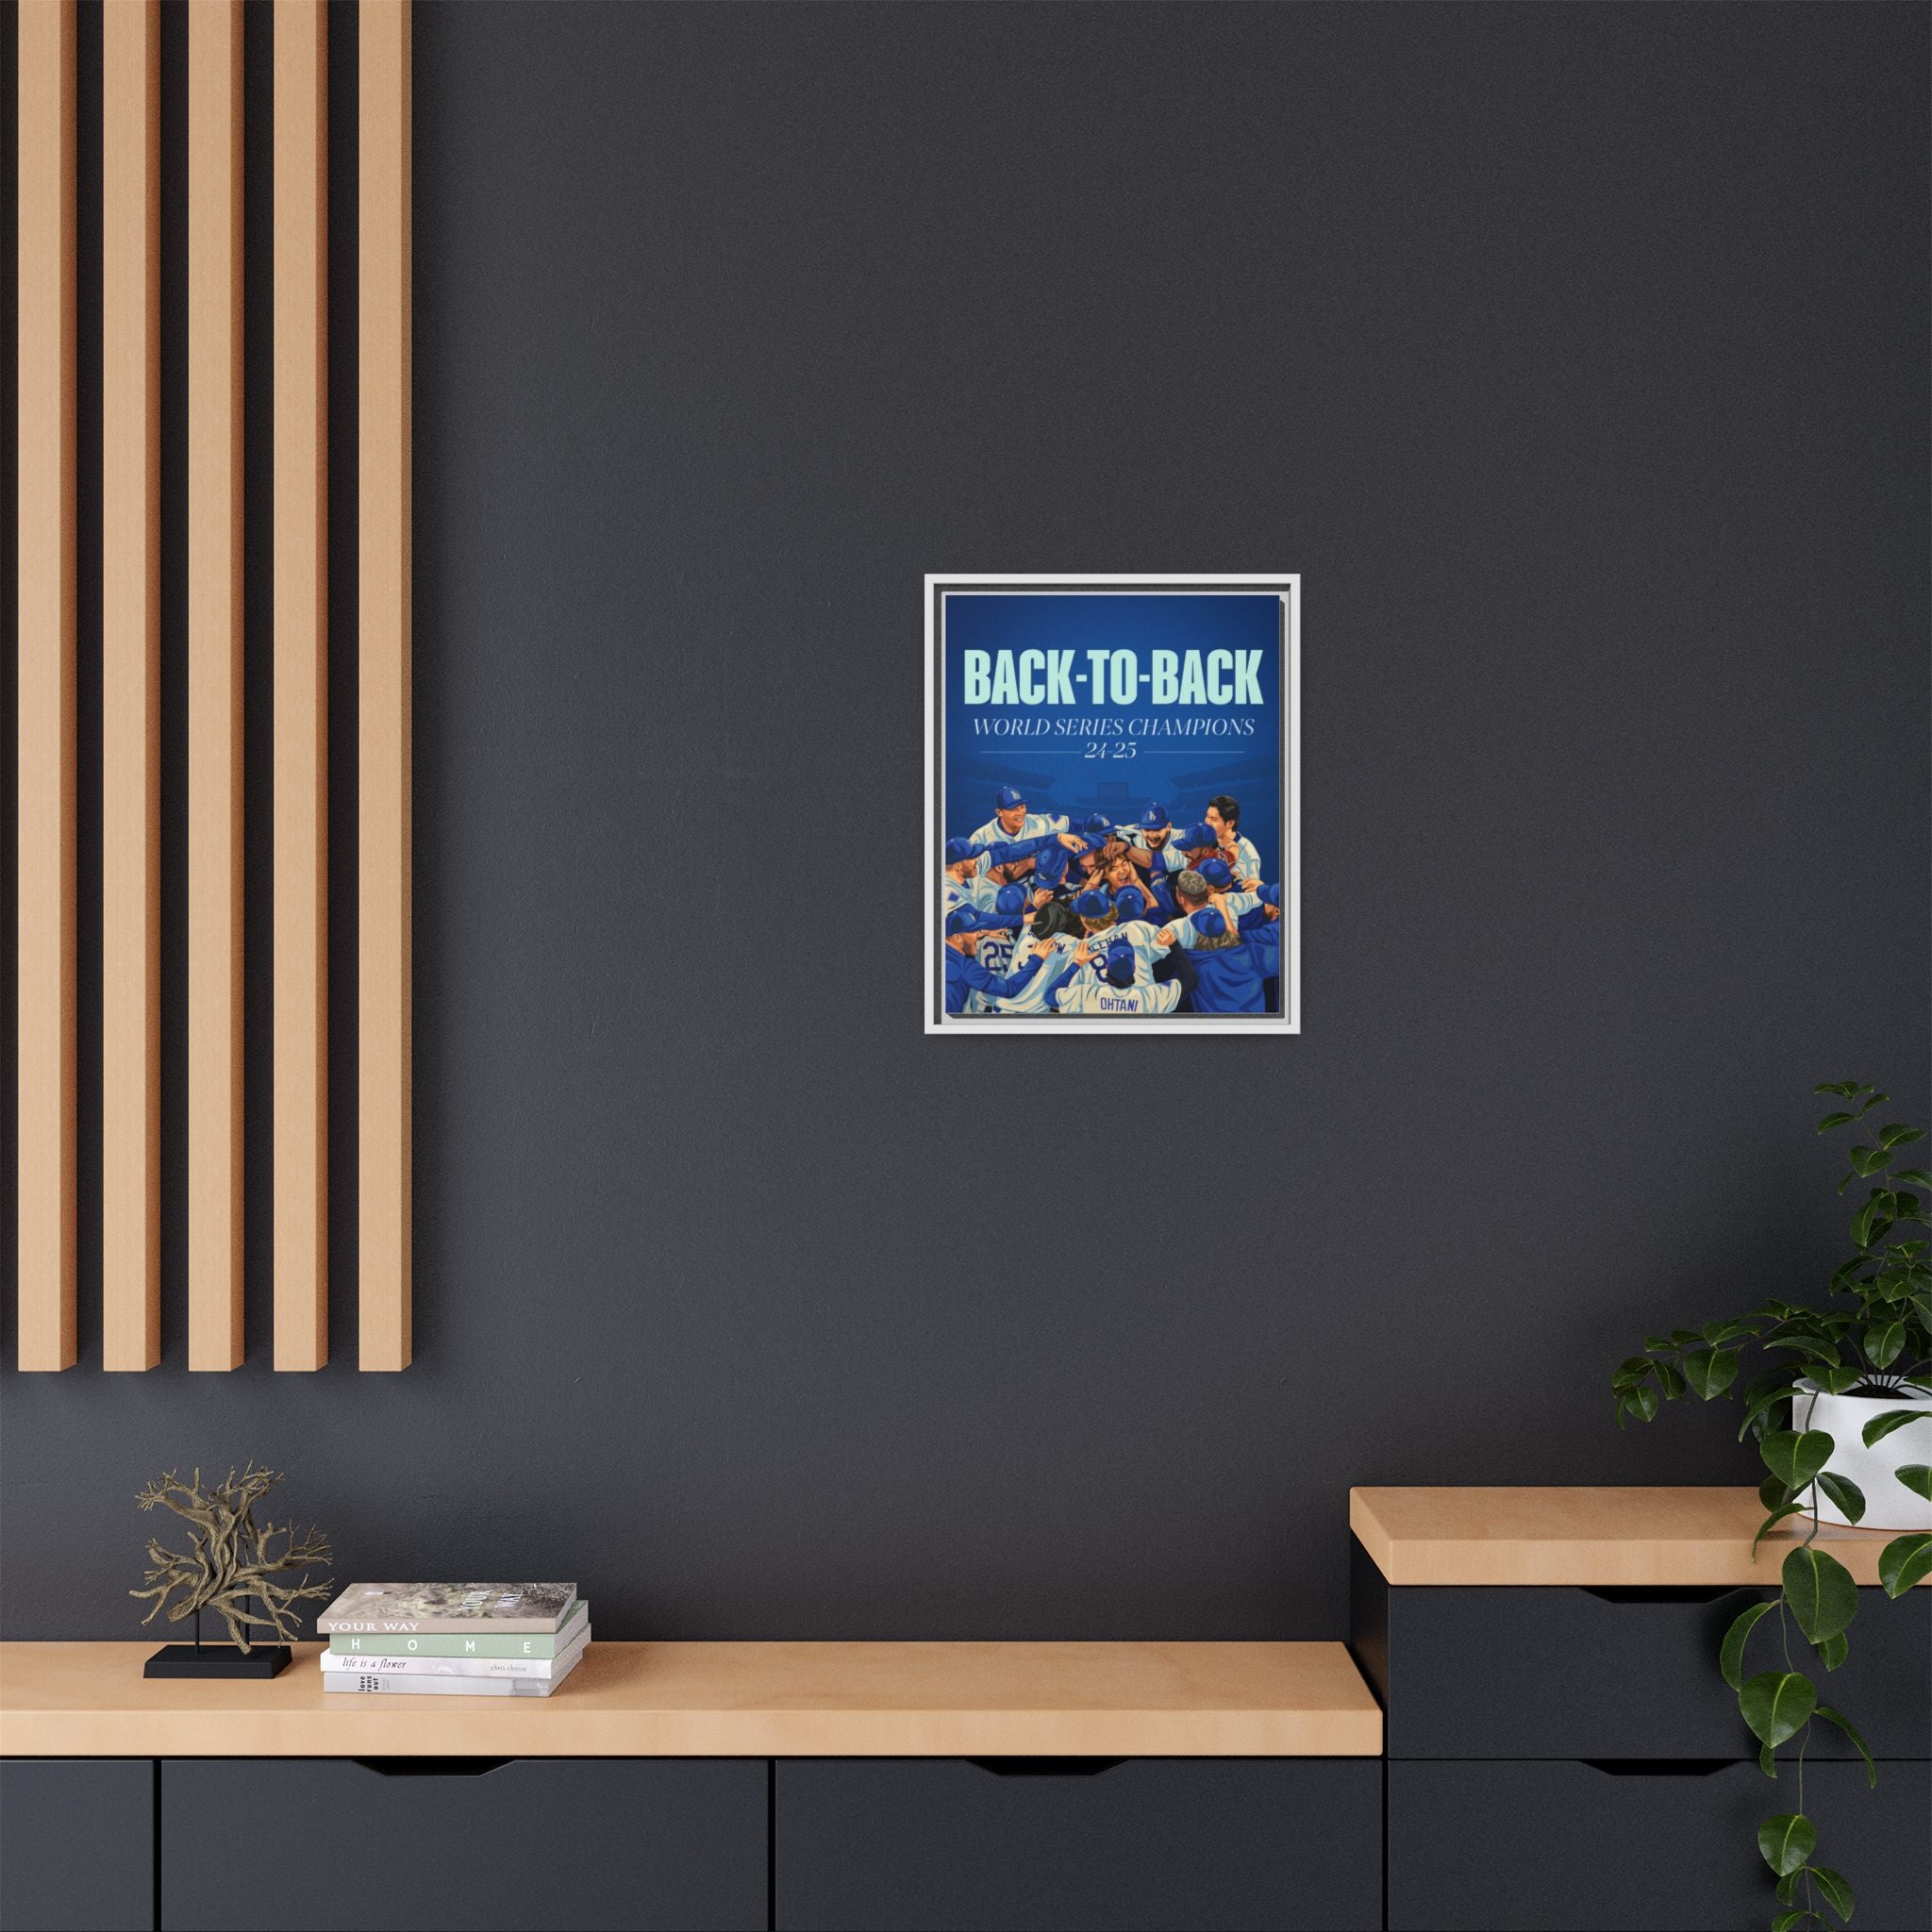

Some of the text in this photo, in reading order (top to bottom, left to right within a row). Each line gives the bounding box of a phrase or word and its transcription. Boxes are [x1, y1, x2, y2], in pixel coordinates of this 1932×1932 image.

[964, 648, 1264, 705] BACK-TO-BACK
[974, 718, 1255, 736] WORLD SERIES CHAMPIONS
[1100, 997, 1139, 1012] OHTANI
[327, 1623, 421, 1631] YOUR WAY
[342, 1657, 357, 1671] life
[360, 1659, 367, 1668] is
[377, 1658, 407, 1671] flower
